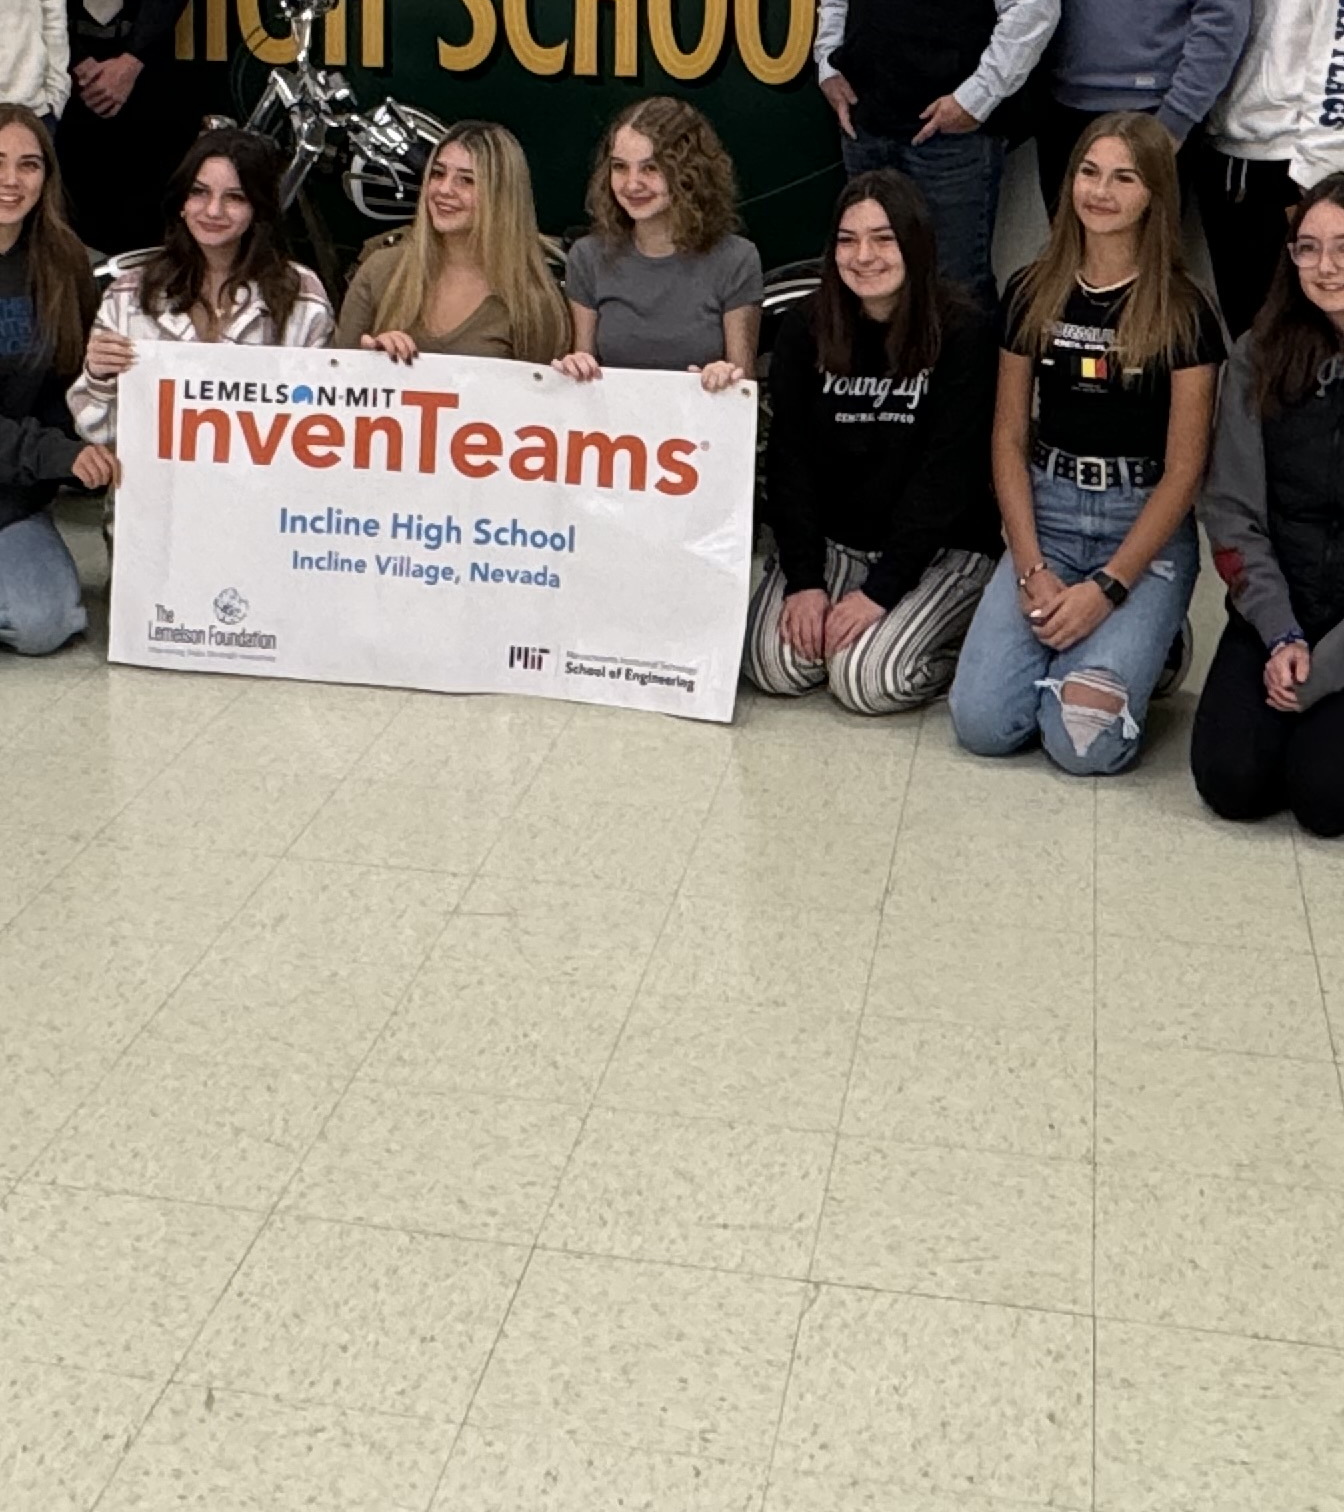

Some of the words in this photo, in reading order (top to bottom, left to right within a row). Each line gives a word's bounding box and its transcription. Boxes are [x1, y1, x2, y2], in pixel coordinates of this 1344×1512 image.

[818, 365, 894, 409] Young
[278, 506, 381, 536] Incline
[390, 512, 463, 551] High
[472, 518, 577, 554] School
[291, 549, 368, 575] Incline
[374, 553, 462, 586] Village,
[469, 561, 562, 589] Nevada
[155, 603, 175, 623] The
[208, 624, 277, 649] Foundation
[565, 660, 606, 677] School
[608, 667, 622, 680] of
